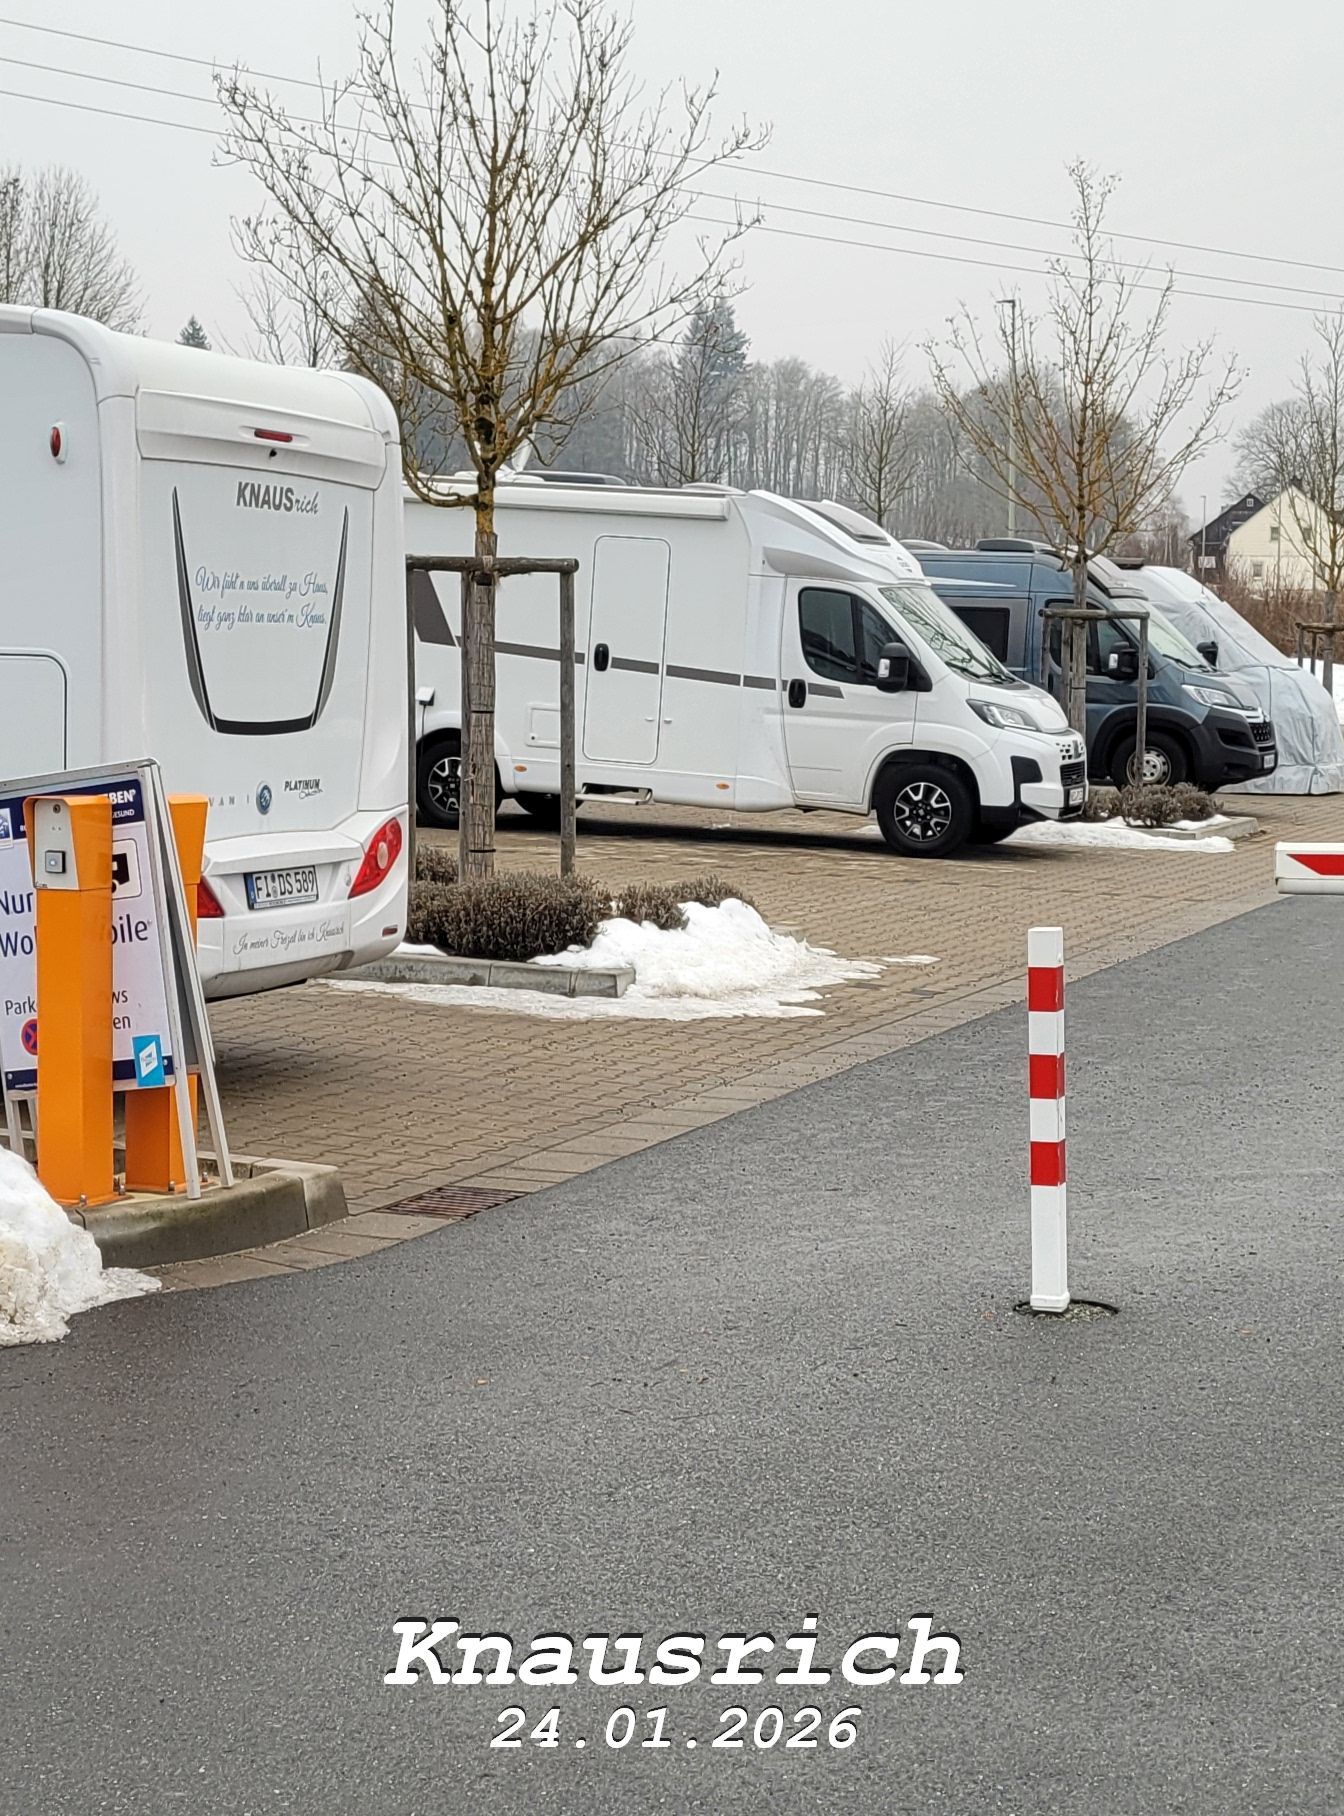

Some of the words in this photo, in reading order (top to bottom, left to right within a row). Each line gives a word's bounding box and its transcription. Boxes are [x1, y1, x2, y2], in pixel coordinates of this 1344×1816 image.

[236, 481, 319, 515] KNAUSrich
[195, 566, 220, 592] Wir
[197, 604, 216, 631] liegt
[215, 611, 236, 631] ganz
[237, 604, 253, 623] klar
[255, 612, 265, 623] an
[284, 779, 320, 792] PLATINUM
[255, 875, 272, 899] FI
[277, 872, 294, 897] DS
[294, 870, 315, 894] 589
